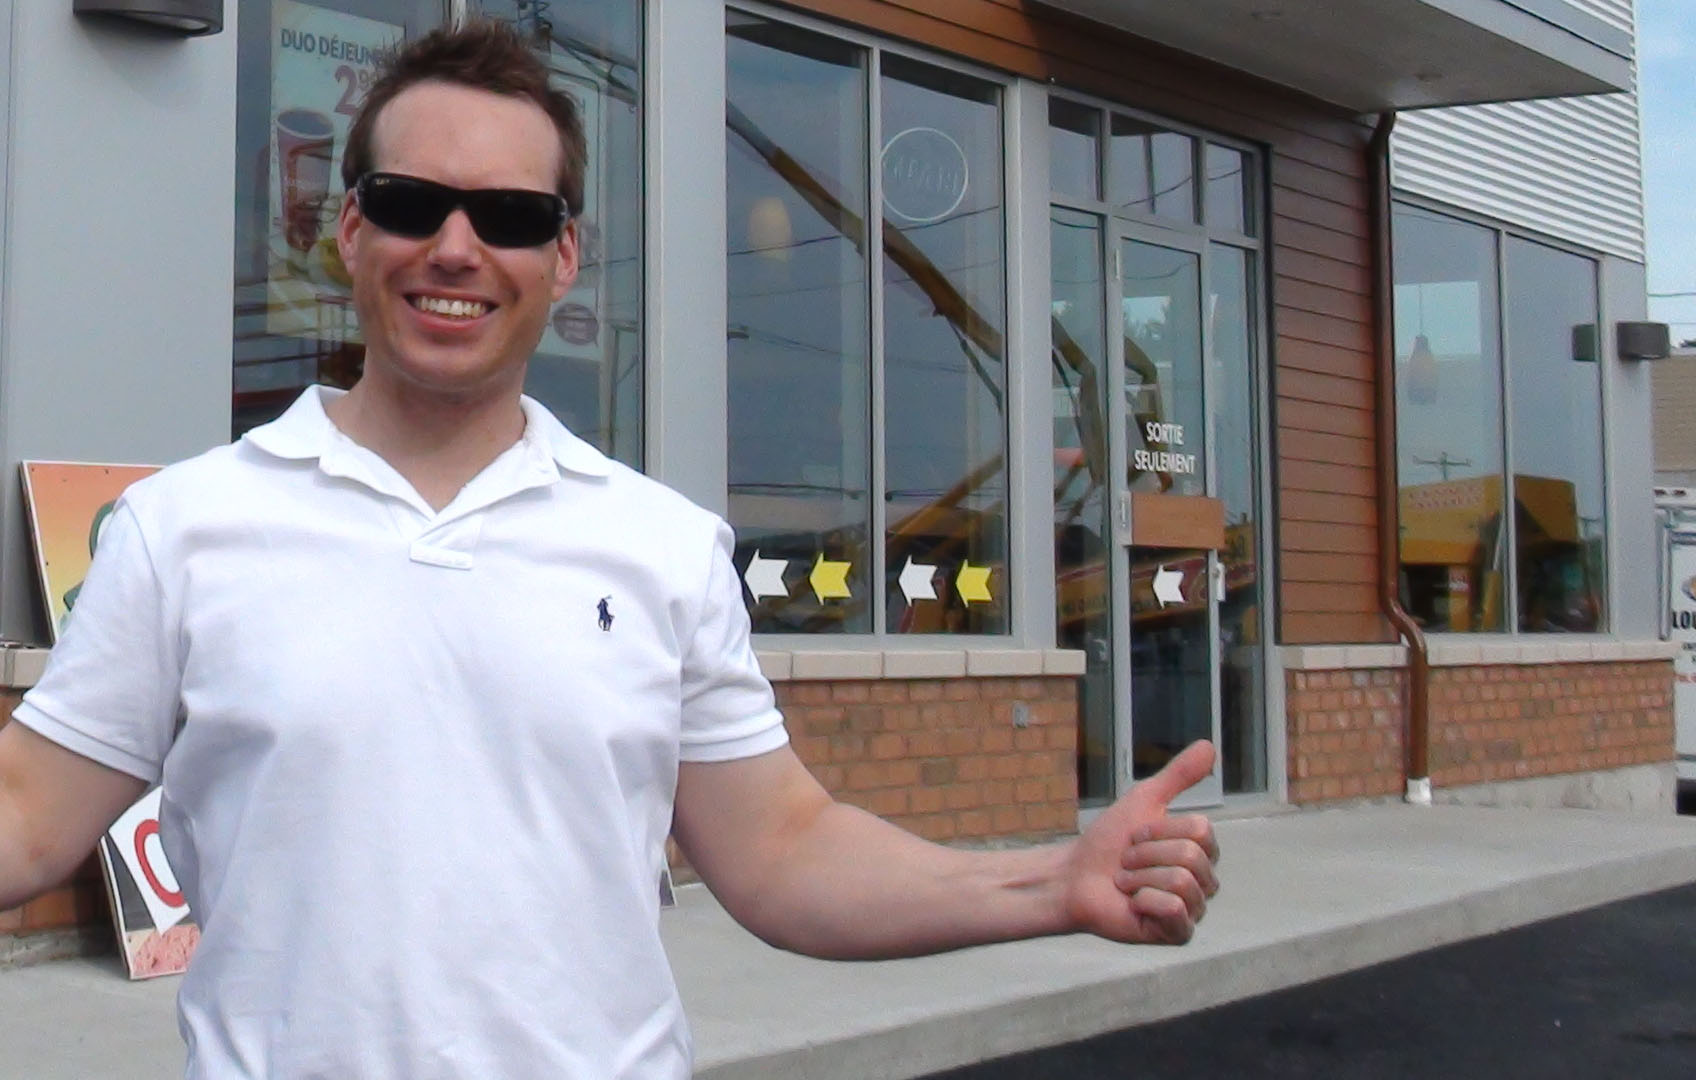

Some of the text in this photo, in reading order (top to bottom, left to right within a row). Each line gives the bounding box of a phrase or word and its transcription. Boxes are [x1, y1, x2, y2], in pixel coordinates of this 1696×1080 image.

[281, 28, 316, 53] DUO
[1146, 422, 1184, 446] SORTIE
[1135, 450, 1196, 474] SEULEMENT
